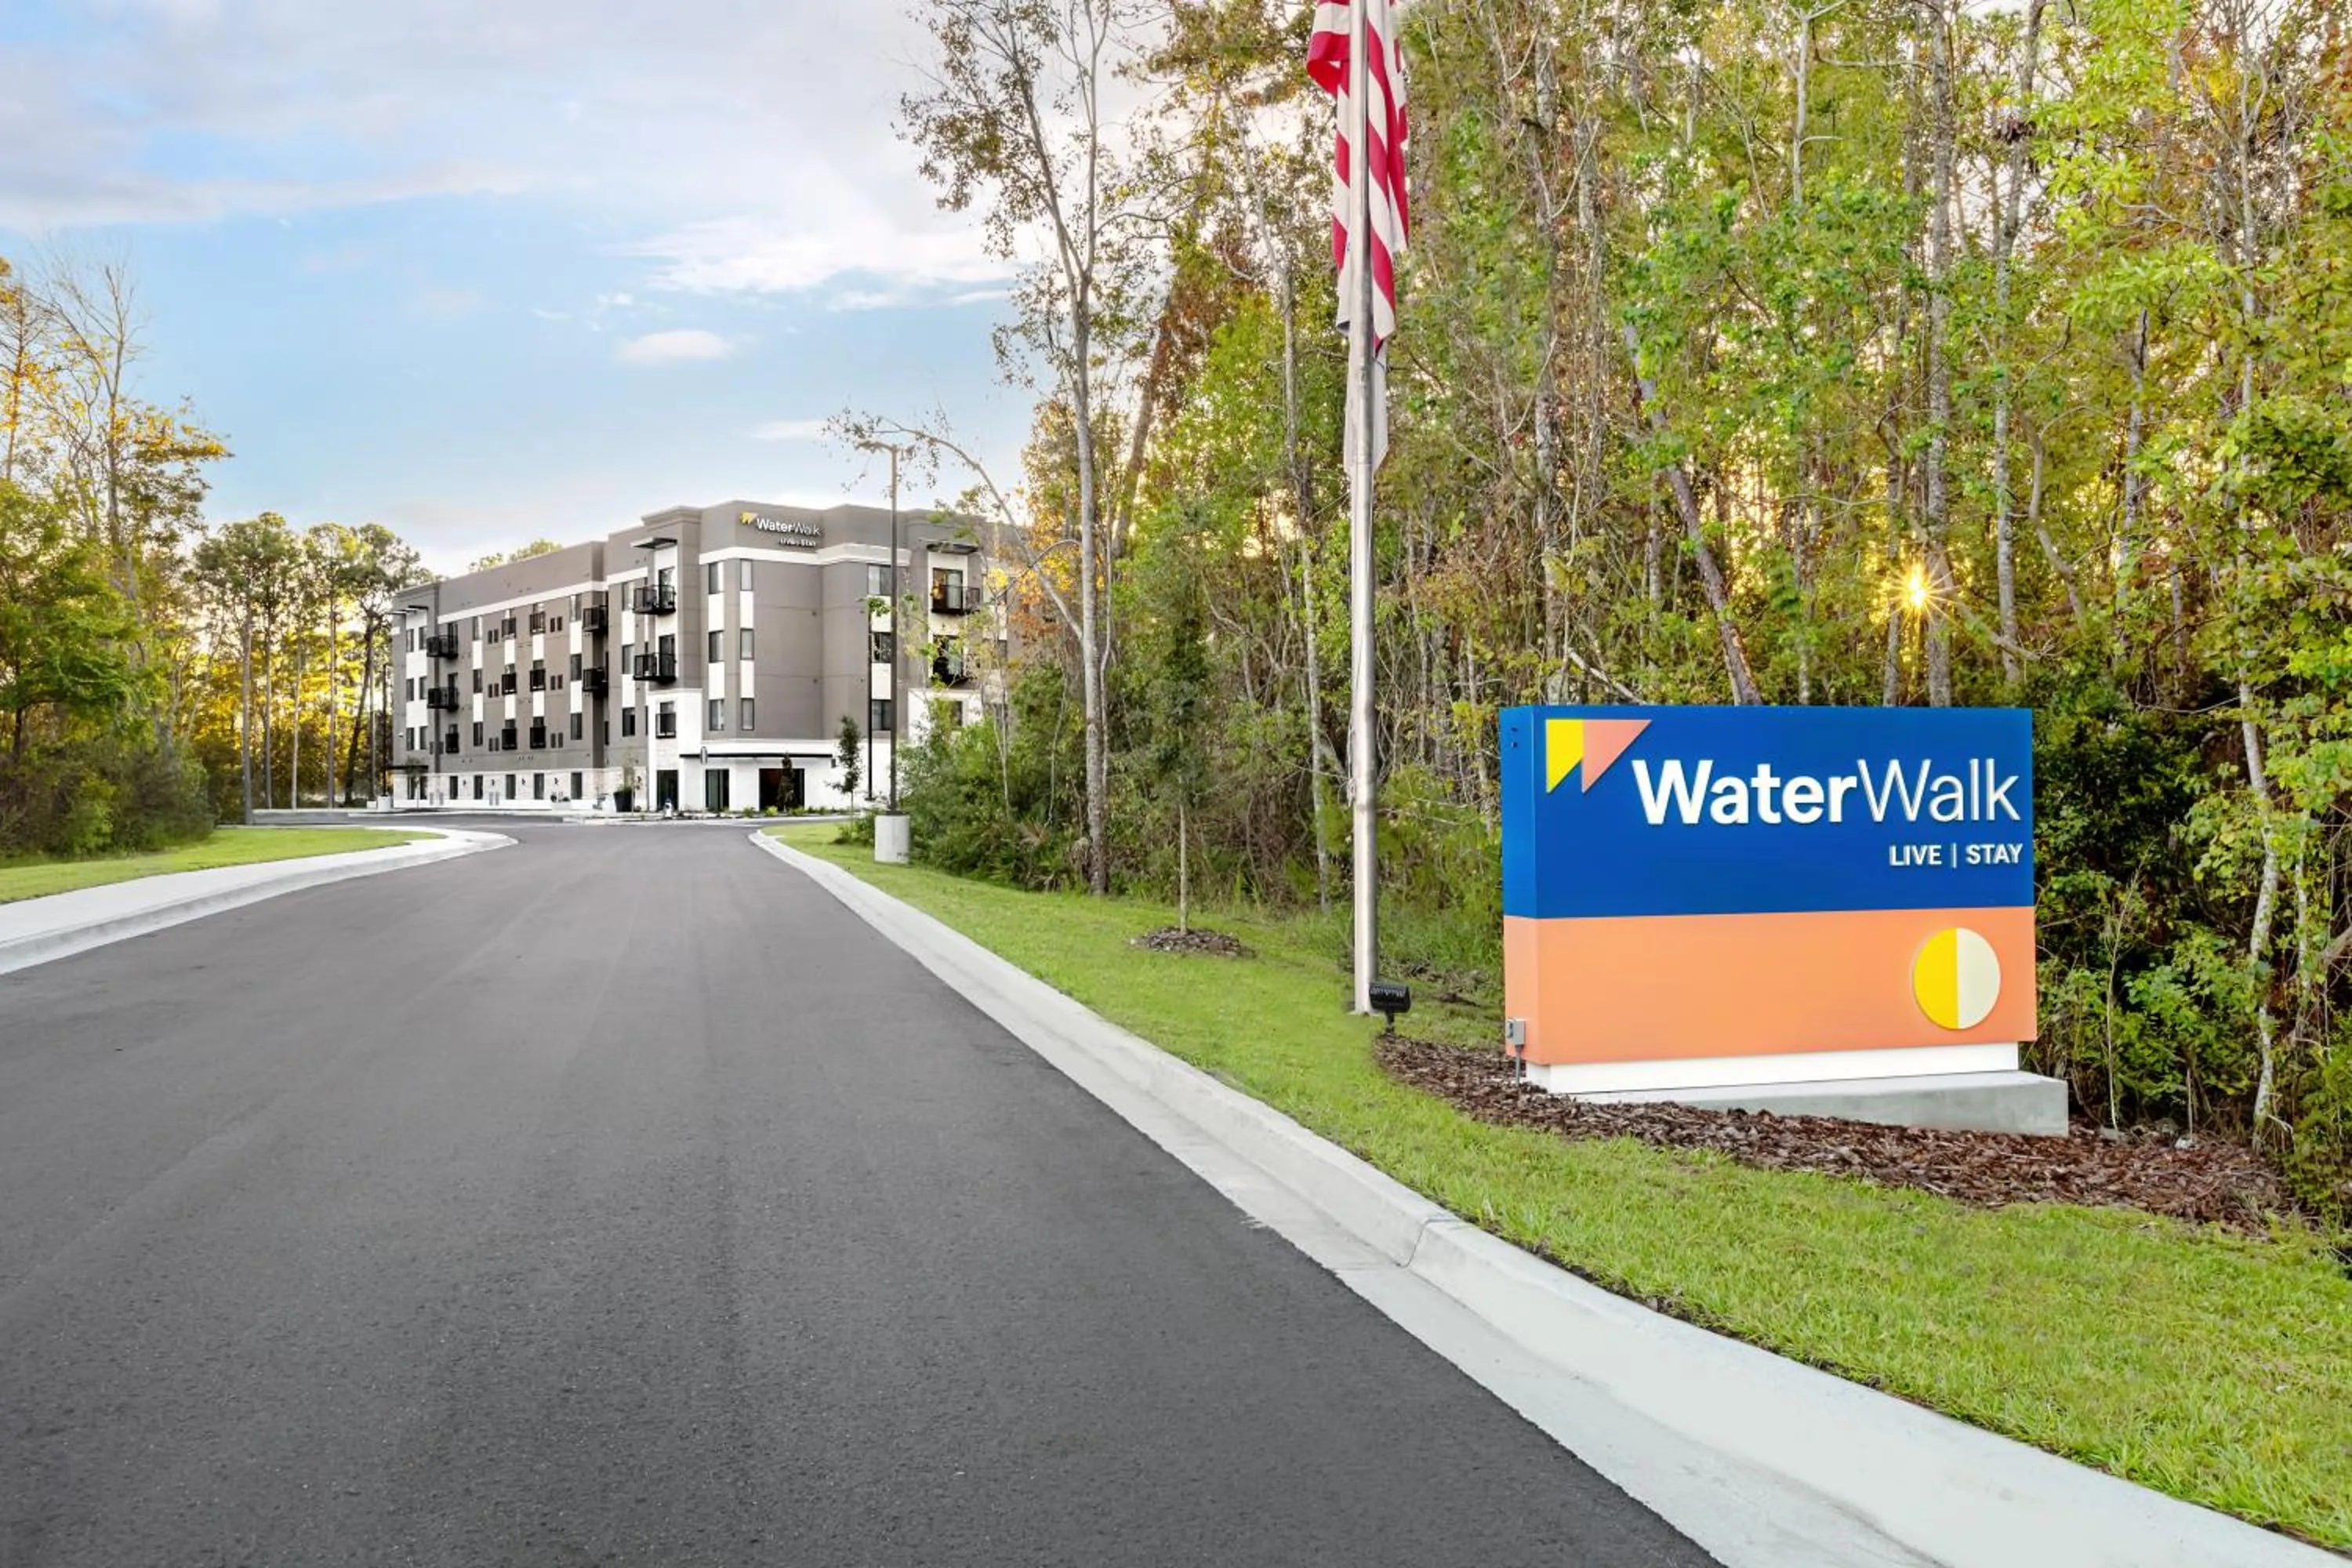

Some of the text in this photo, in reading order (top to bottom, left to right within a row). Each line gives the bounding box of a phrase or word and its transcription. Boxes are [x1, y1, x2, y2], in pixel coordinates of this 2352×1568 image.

[1631, 758, 2021, 825] WaterWalk
[1889, 844, 1942, 866] LIVE
[1965, 843, 2024, 865] STAY
